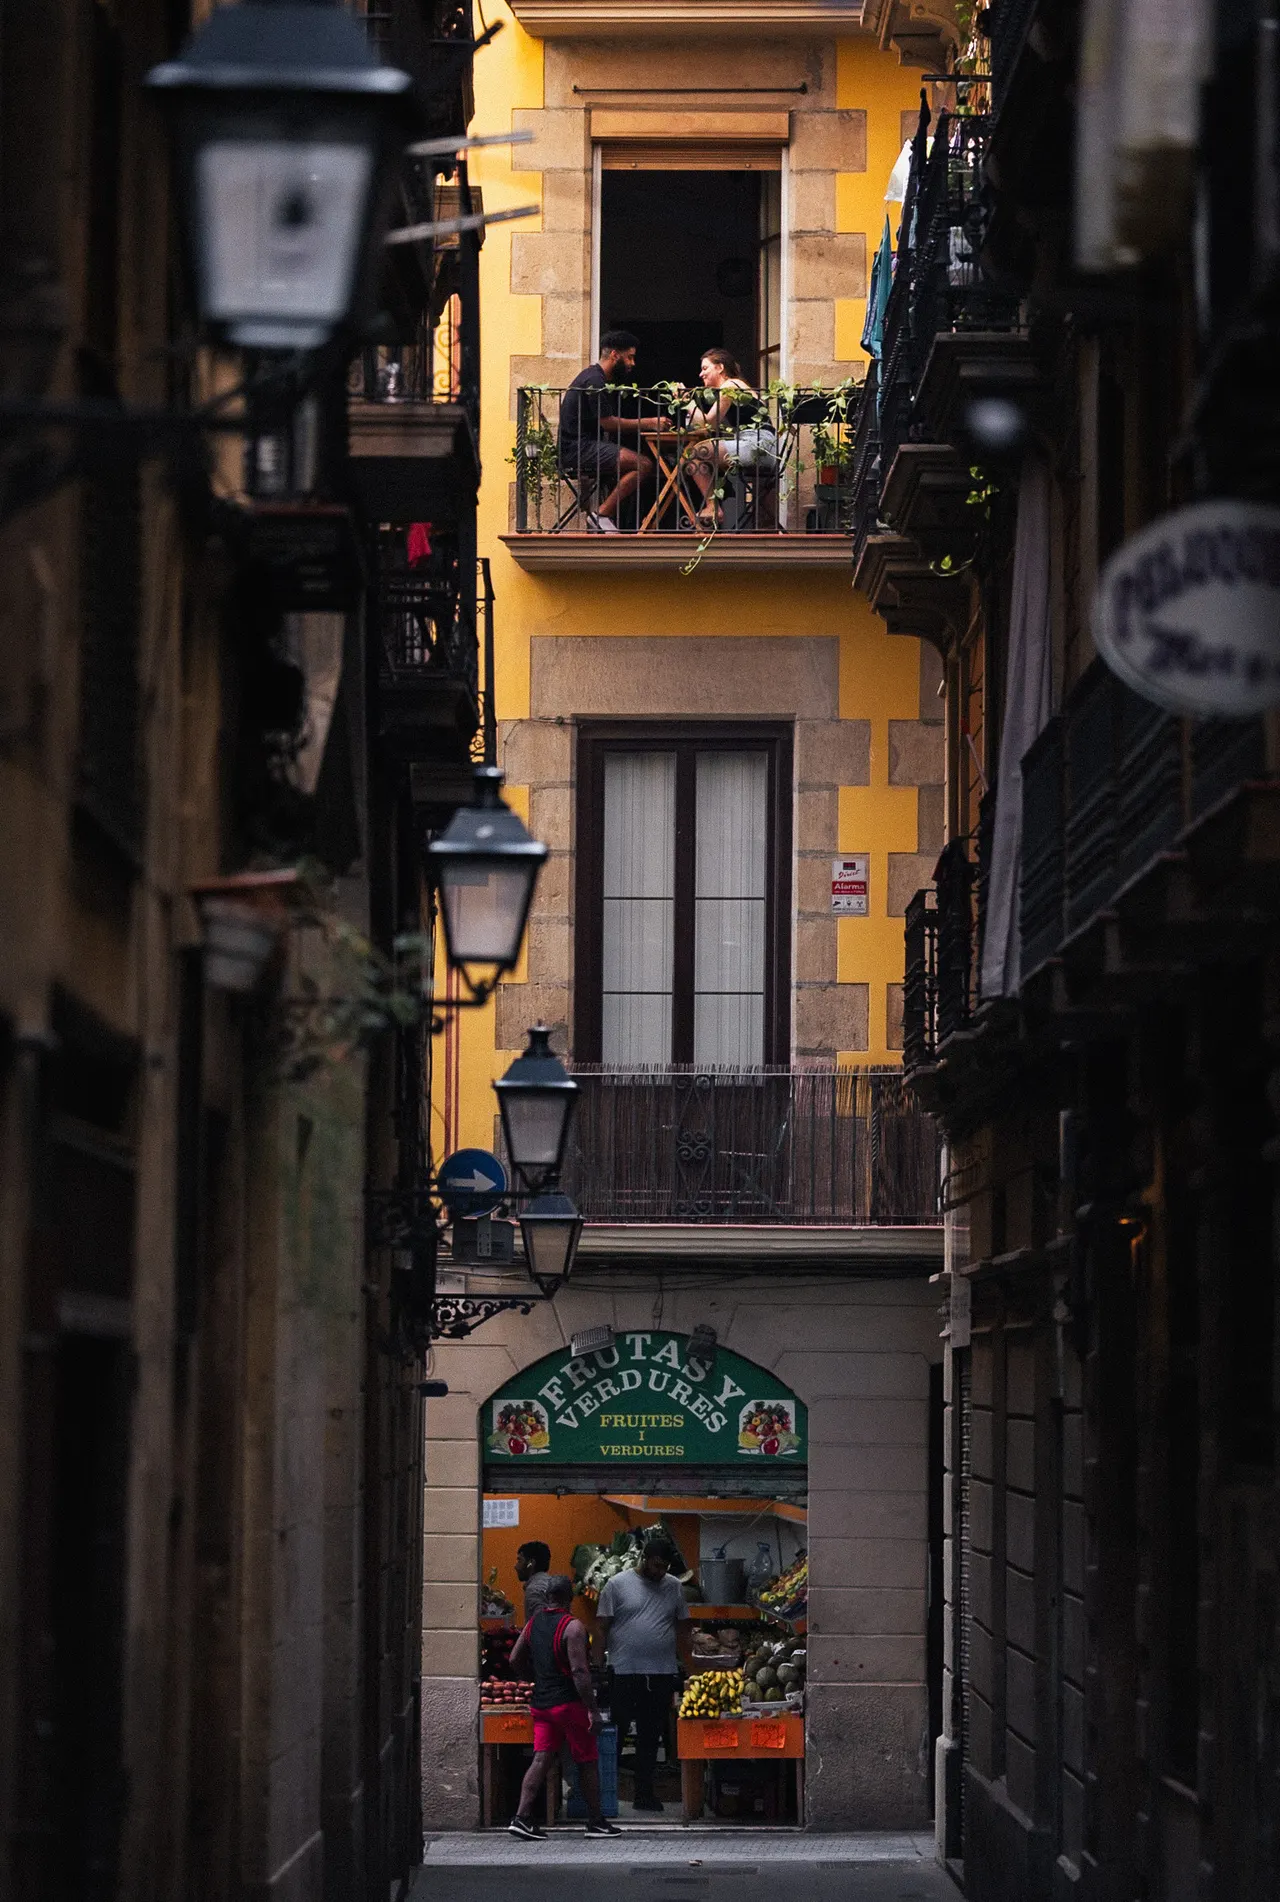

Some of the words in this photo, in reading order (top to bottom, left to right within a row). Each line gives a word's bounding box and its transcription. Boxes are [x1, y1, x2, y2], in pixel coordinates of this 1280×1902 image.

[834, 882, 865, 890] Alarma
[538, 1334, 713, 1411] FRUTAS
[713, 1374, 746, 1408] Y
[556, 1368, 728, 1433] VERDURES
[599, 1414, 685, 1428] FRUITES
[639, 1431, 645, 1441] I
[599, 1445, 685, 1456] VERDURES
